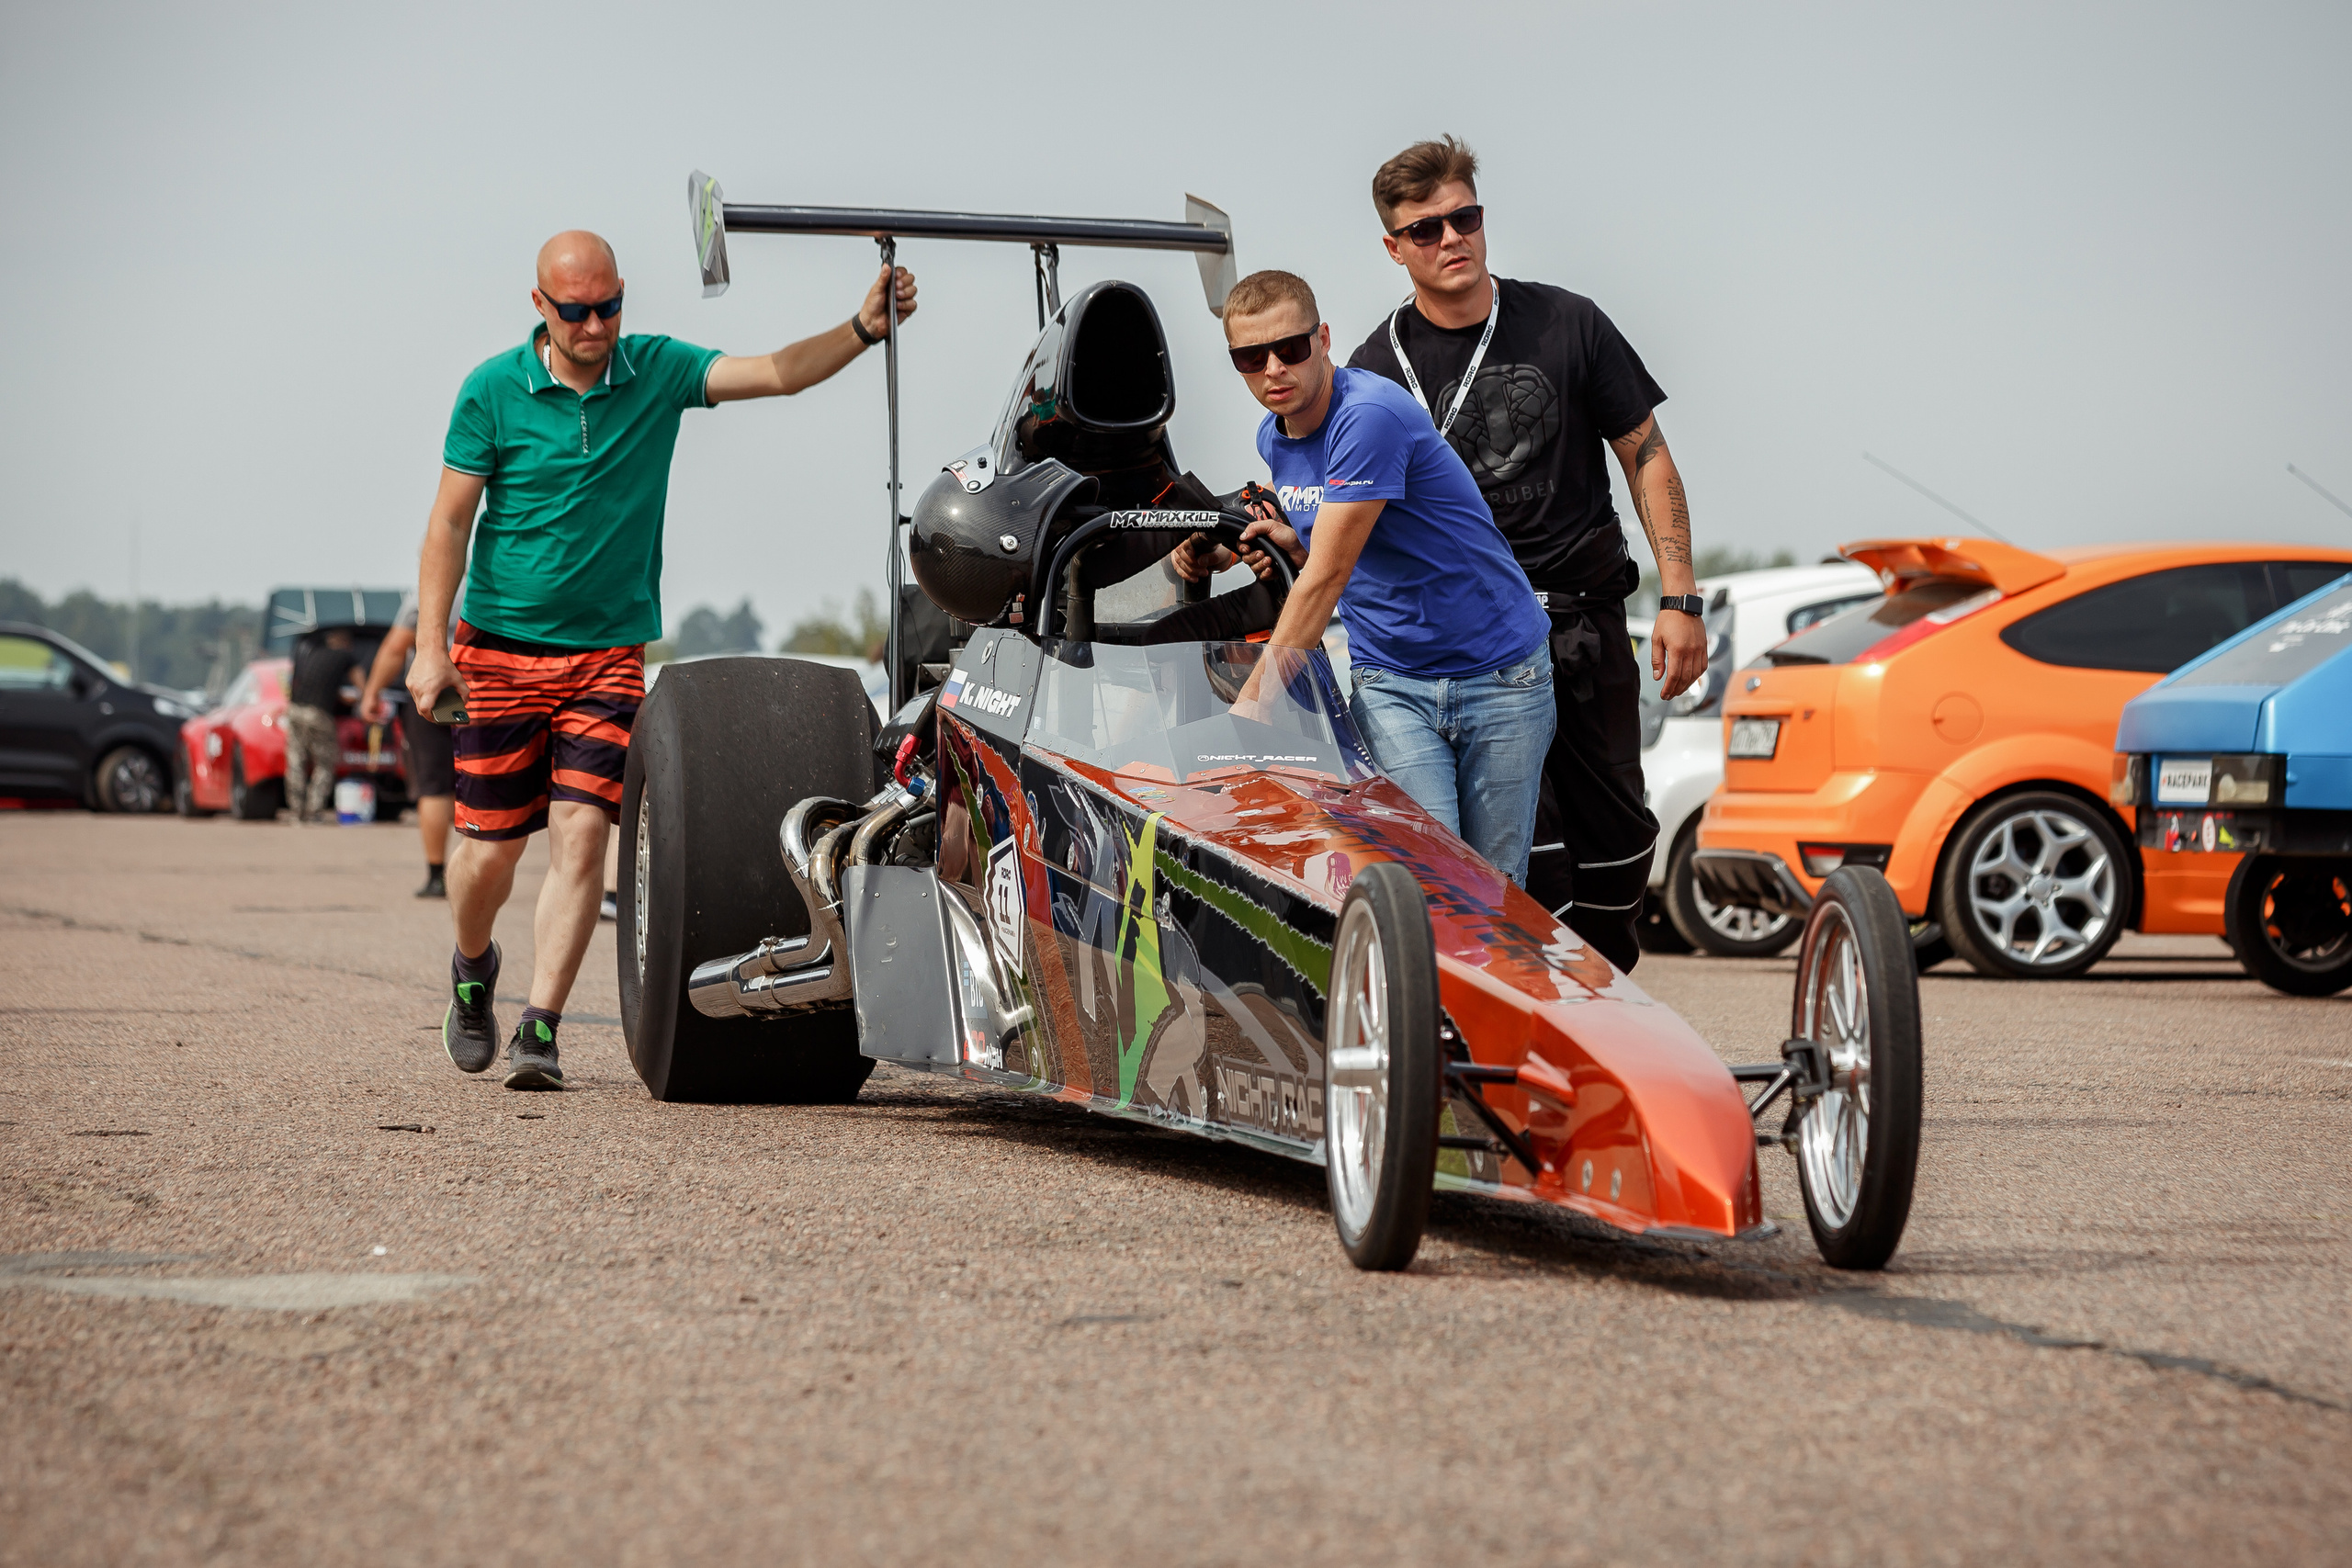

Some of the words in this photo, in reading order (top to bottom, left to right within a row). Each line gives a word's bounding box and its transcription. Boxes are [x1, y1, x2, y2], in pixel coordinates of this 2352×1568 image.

[1481, 324, 1494, 347] RDRC
[1404, 366, 1419, 389] RDRC
[1463, 365, 1476, 389] RDRC
[1443, 406, 1458, 430] RDRC
[1482, 479, 1558, 506] RUBEL
[973, 685, 1022, 718] NIGHT
[998, 884, 1012, 925] 11
[1280, 1081, 1323, 1134] RAC
